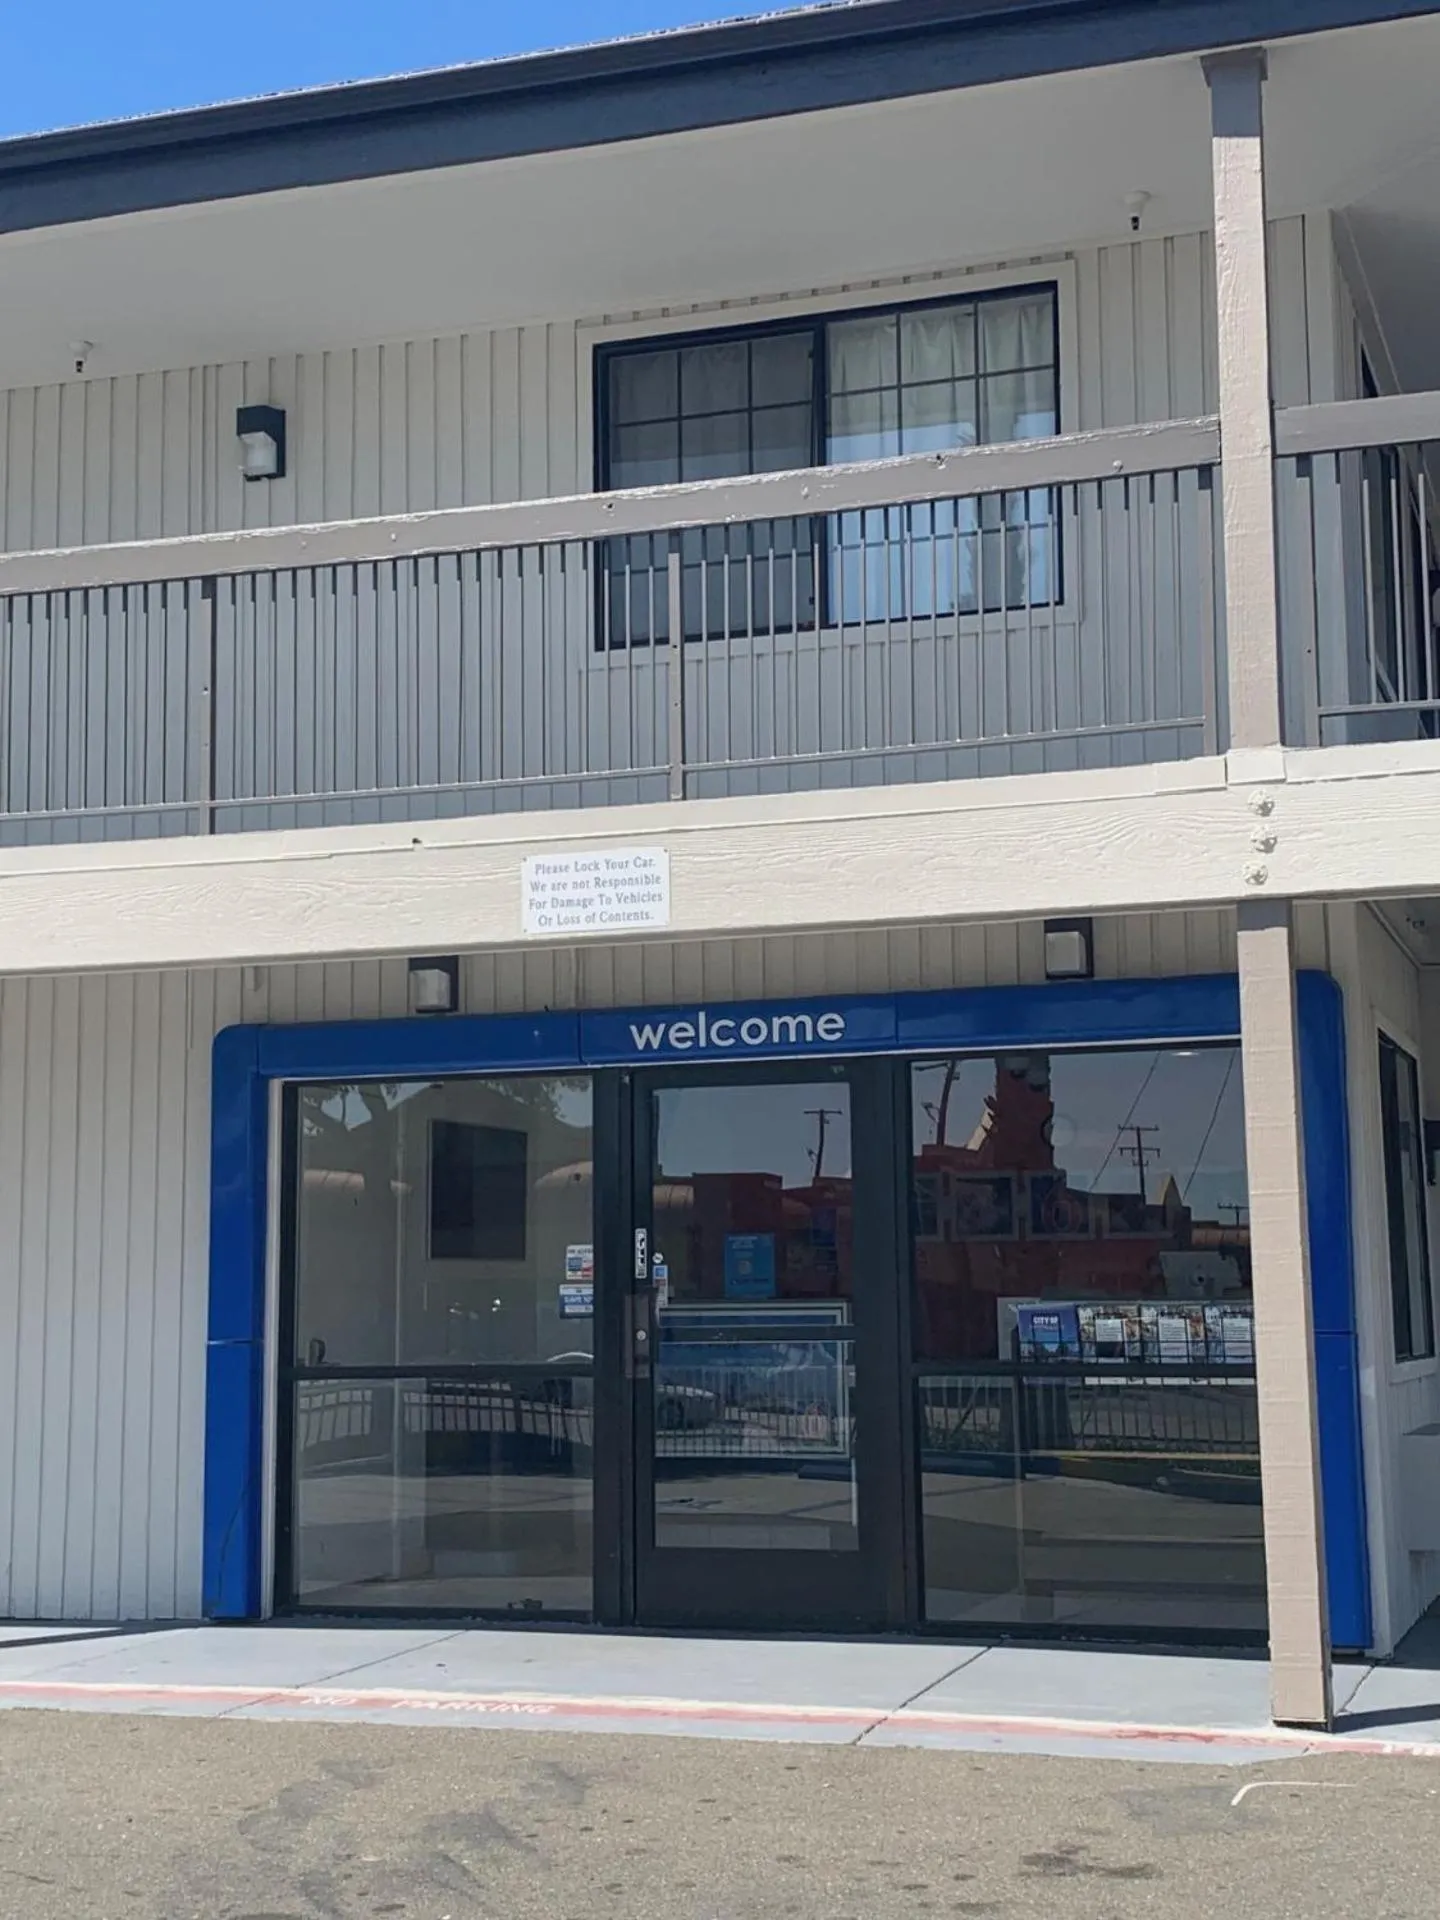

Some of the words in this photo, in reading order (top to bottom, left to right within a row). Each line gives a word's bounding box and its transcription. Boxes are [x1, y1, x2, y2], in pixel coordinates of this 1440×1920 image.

[535, 863, 570, 876] Please
[574, 860, 600, 873] Lock
[605, 858, 630, 871] Your
[633, 856, 656, 869] Car.
[530, 881, 546, 893] We
[551, 880, 567, 892] are
[572, 879, 590, 890] not
[594, 874, 662, 890] Responsible
[529, 898, 547, 910] For
[551, 896, 595, 910] Damage
[599, 893, 612, 906] To
[615, 891, 663, 905] Vehicles
[538, 915, 553, 927] Or
[557, 913, 581, 926] Loss
[585, 912, 596, 923] of
[600, 910, 655, 923] Contents.
[629, 1011, 846, 1051] welcome
[391, 1699, 556, 1714] PARKING
